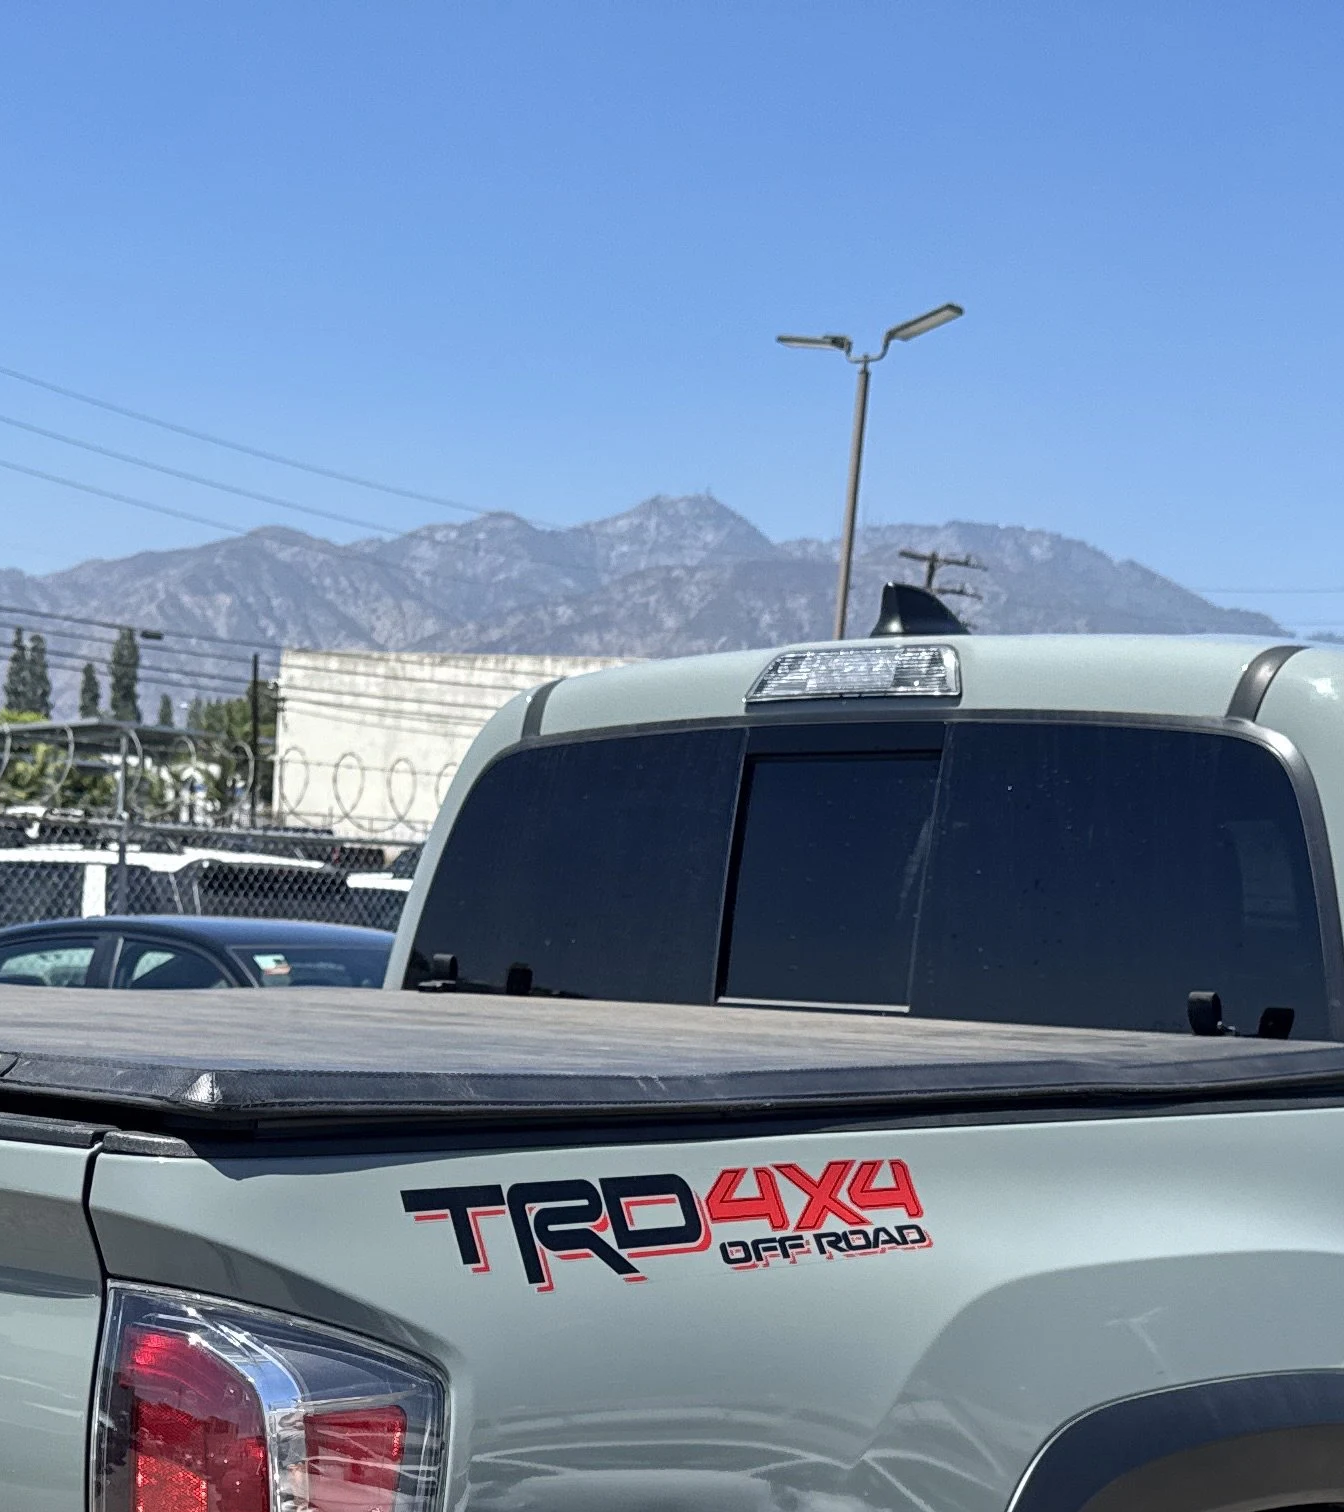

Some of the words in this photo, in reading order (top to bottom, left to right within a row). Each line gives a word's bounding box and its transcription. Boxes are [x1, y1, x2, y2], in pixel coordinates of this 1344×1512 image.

[399, 1173, 712, 1293] TRD
[704, 1158, 925, 1232] 4X4
[718, 1233, 813, 1271] OFF
[813, 1222, 933, 1258] ROAD
